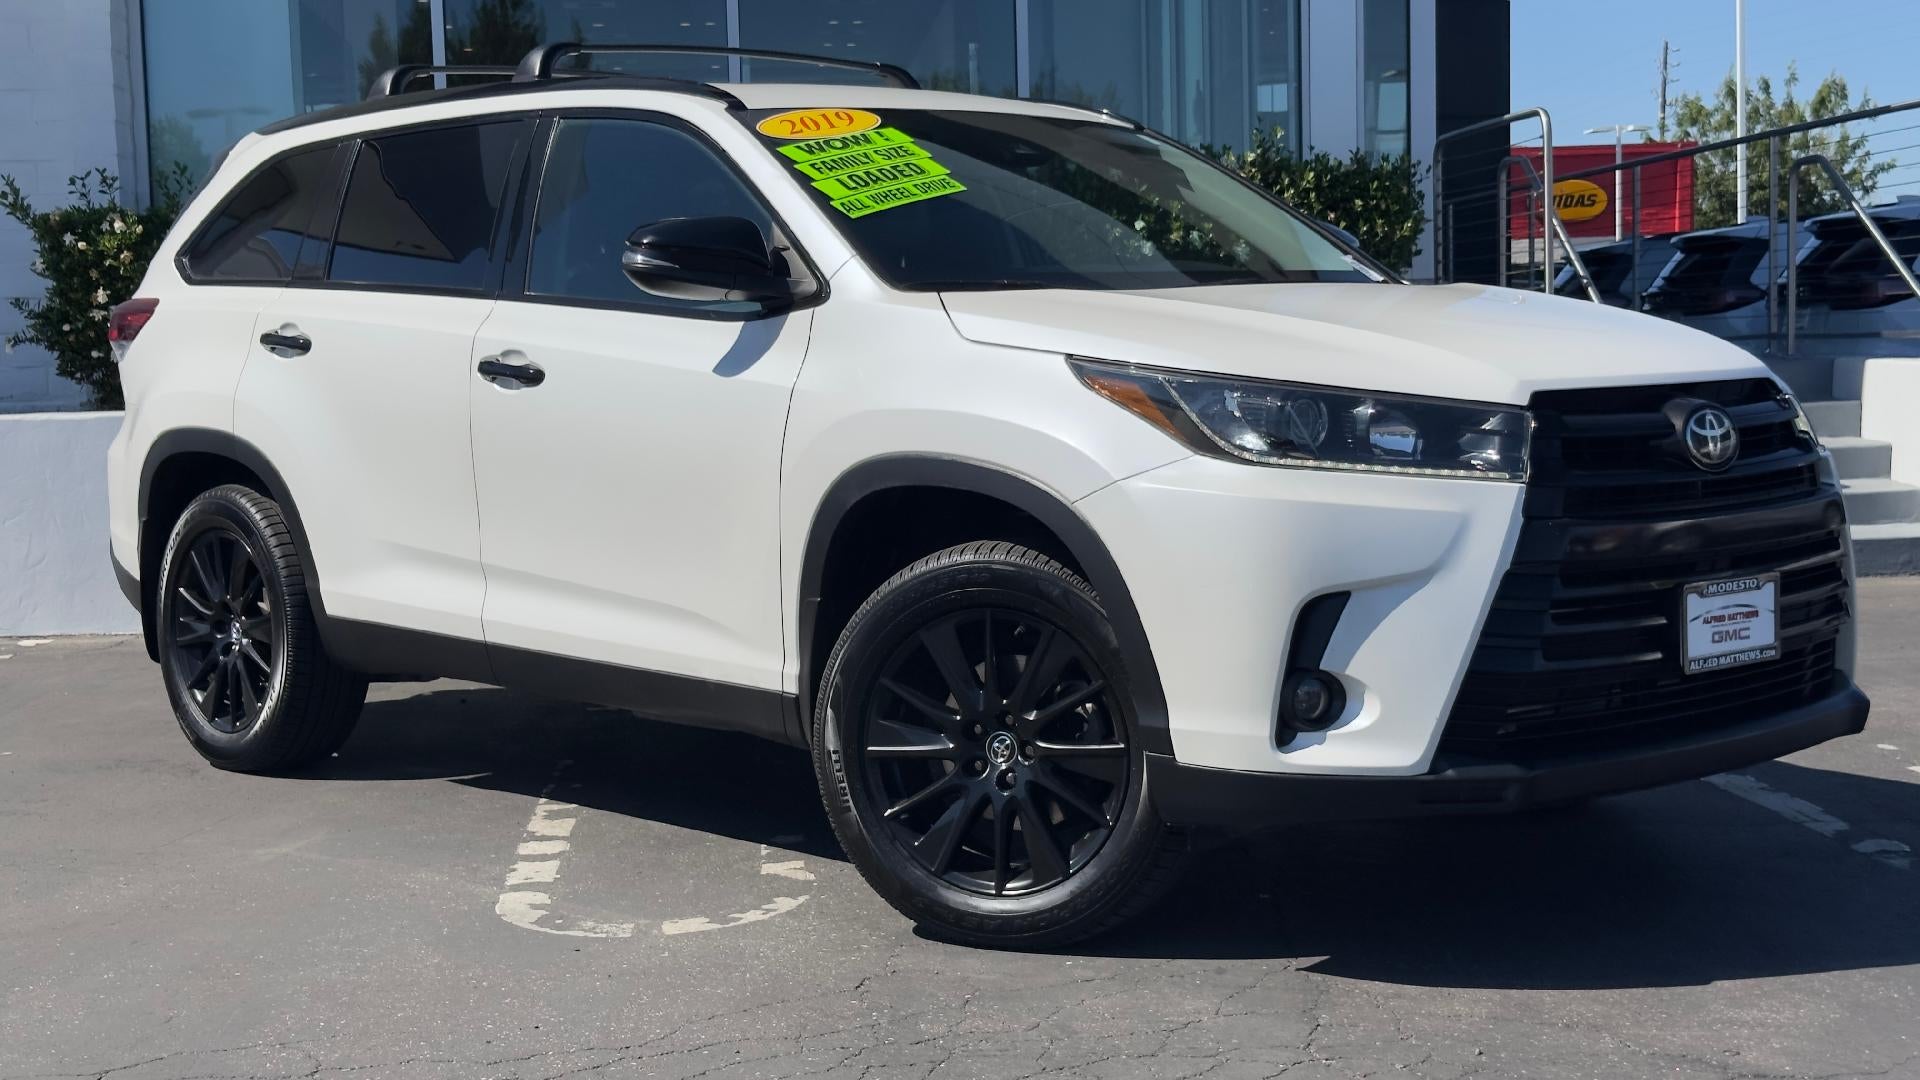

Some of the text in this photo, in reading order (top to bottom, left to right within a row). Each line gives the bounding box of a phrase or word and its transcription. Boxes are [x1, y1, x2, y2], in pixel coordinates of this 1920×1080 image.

[780, 111, 855, 135] 2019
[795, 134, 871, 156] WOW
[809, 145, 915, 174] FAMILY SIZE
[836, 162, 927, 190] LOADED
[839, 178, 954, 214] ALL WHEEL DRIVE
[1552, 194, 1597, 208] IDAS
[1708, 579, 1757, 594] MODESTO
[1712, 627, 1750, 644] GMC
